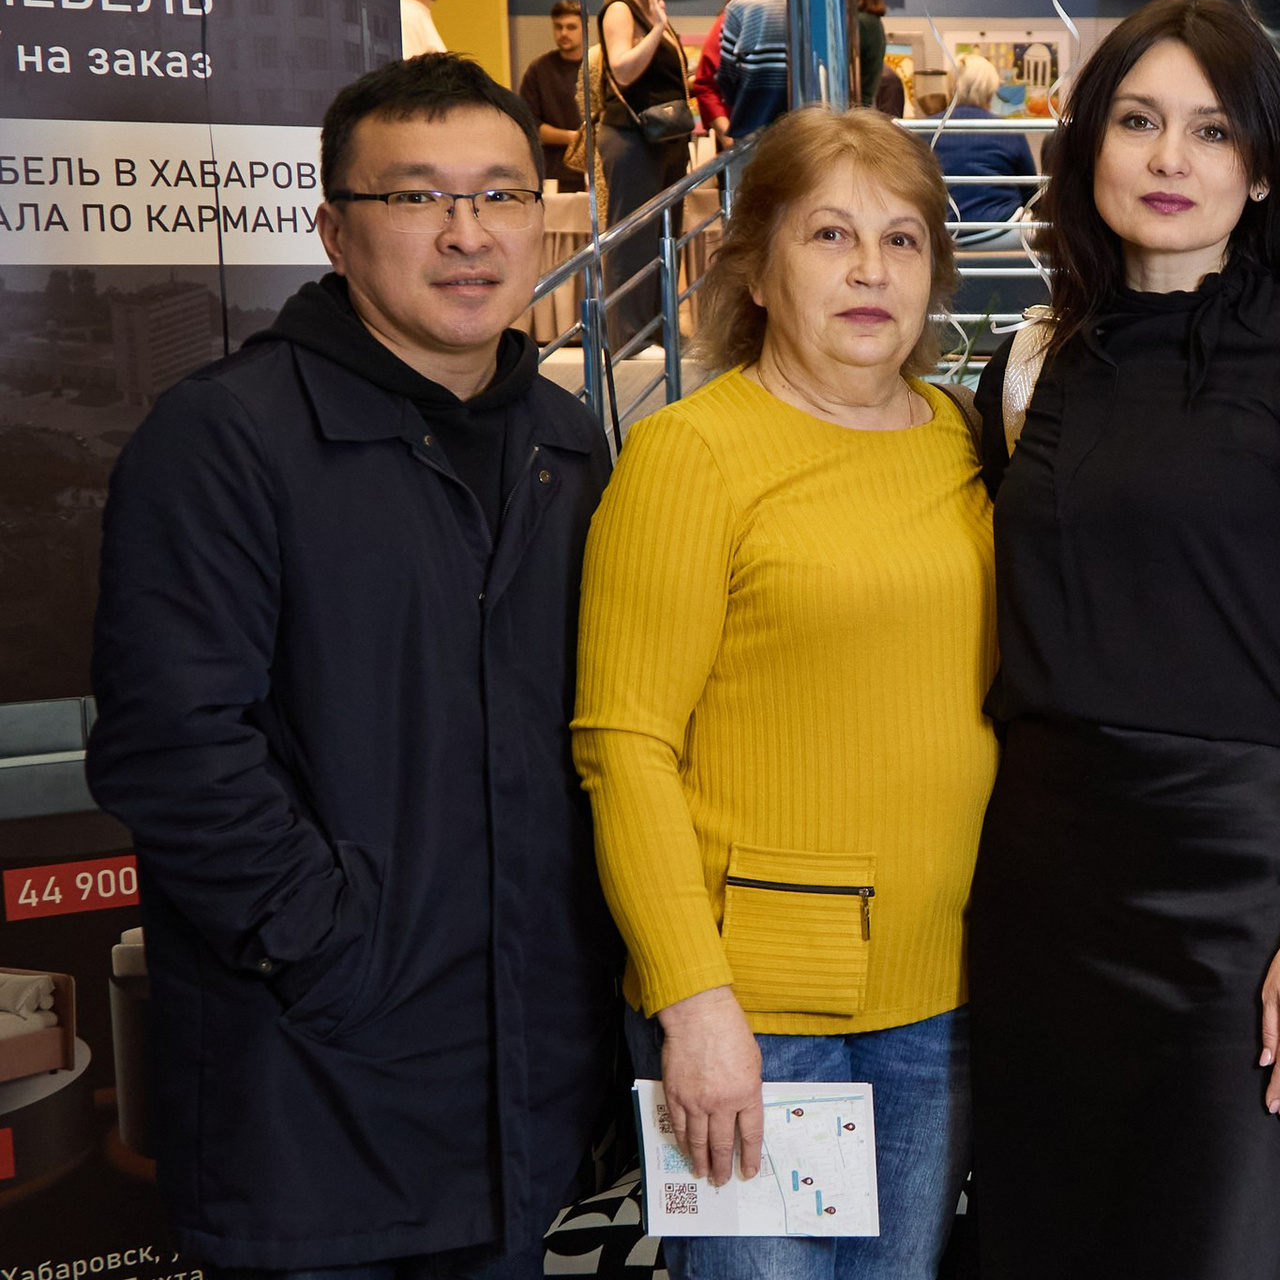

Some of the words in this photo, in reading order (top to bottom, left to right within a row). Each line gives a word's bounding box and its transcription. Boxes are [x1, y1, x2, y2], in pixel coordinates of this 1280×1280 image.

[17, 44, 71, 74] на
[88, 47, 213, 79] заказ
[0, 156, 100, 186] БЕЛЬ
[115, 158, 137, 187] В
[149, 158, 317, 190] ХАБАРОВ
[82, 203, 132, 233] ПО
[146, 204, 318, 234] КАРМАНУ
[18, 876, 62, 907] 44
[75, 866, 138, 901] 900
